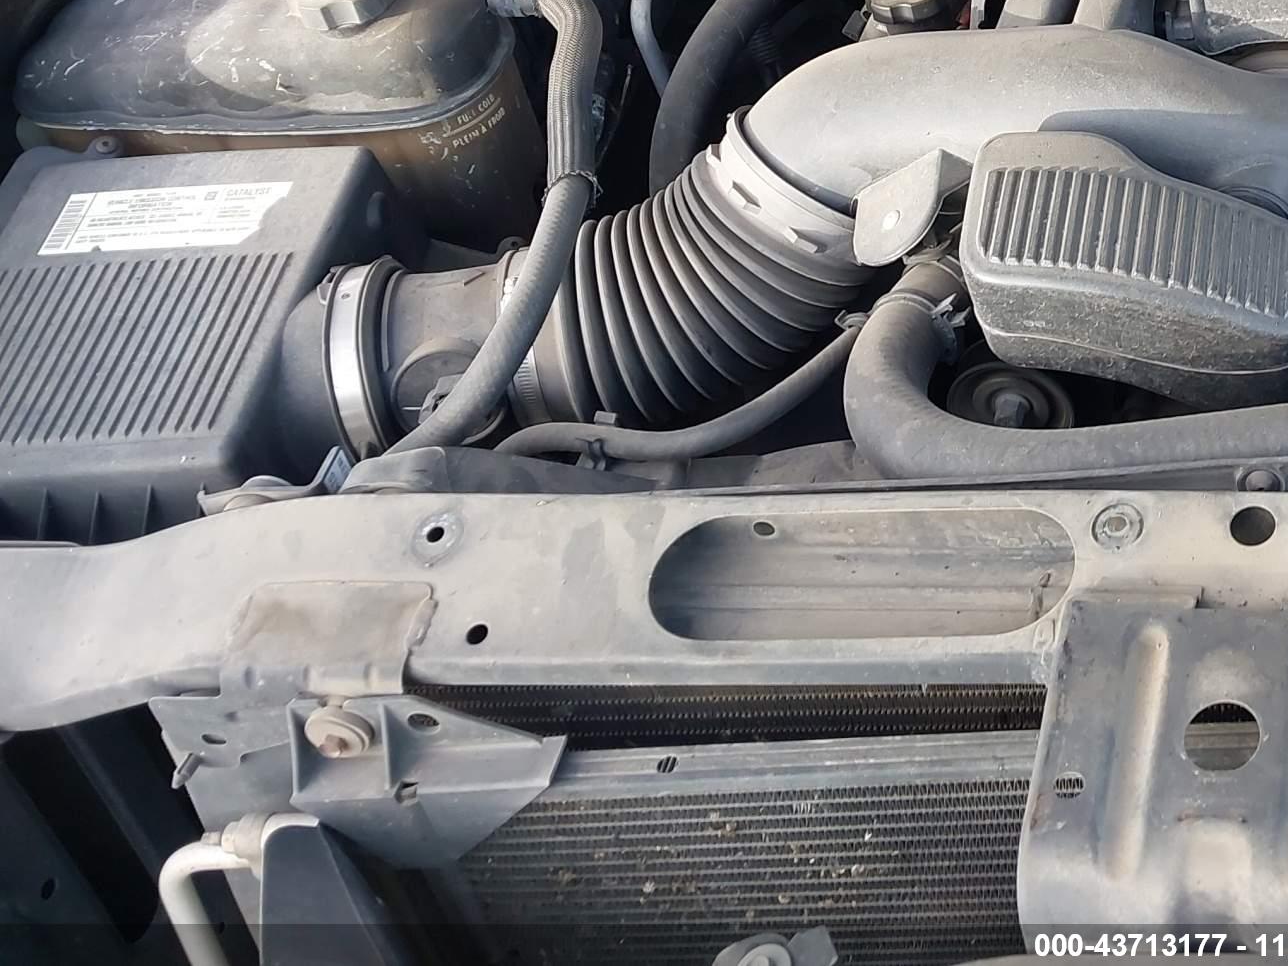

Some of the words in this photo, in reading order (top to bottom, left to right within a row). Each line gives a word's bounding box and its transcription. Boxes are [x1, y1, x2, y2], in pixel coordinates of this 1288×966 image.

[478, 94, 495, 112] COLD
[452, 129, 479, 148] PLEIN
[226, 186, 273, 197] CATALYST
